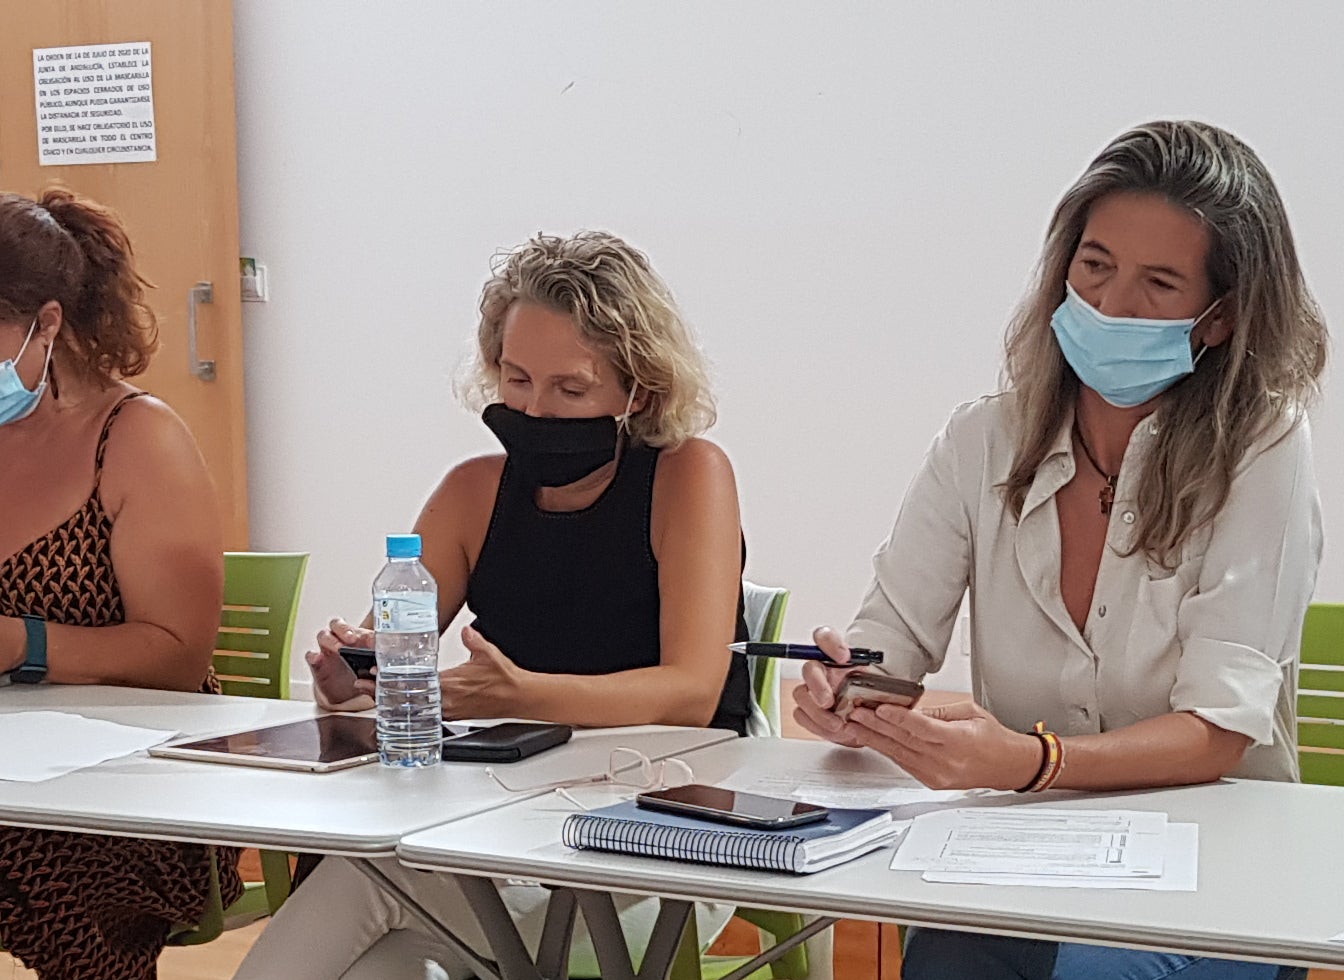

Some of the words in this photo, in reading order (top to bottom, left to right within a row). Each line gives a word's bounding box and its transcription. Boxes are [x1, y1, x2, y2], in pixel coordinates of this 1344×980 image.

[115, 72, 149, 80] MASCARILLA
[94, 85, 123, 93] CERRADOS
[109, 96, 150, 104] GARANTIZARSE
[77, 123, 90, 131] HACE
[53, 135, 86, 143] MASCARILLA
